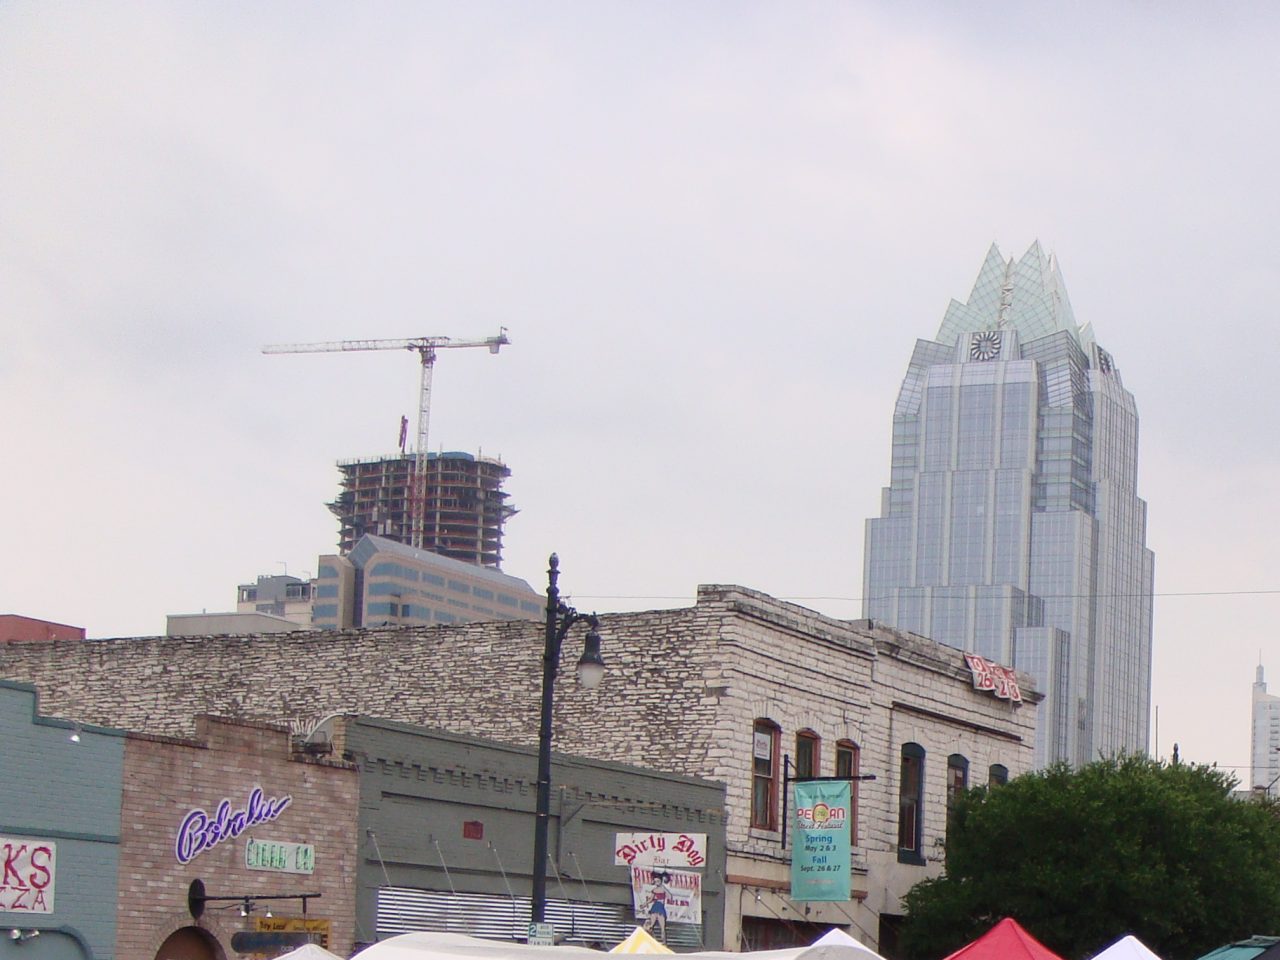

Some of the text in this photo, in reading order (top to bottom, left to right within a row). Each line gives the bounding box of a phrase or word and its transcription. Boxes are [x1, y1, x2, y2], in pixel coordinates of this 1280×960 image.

[797, 803, 845, 823] PECAN
[177, 788, 292, 864] Bobalu
[616, 835, 704, 866] Dirty Dog
[806, 834, 833, 844] Spring
[3, 844, 51, 889] KS
[530, 924, 536, 936] 2
